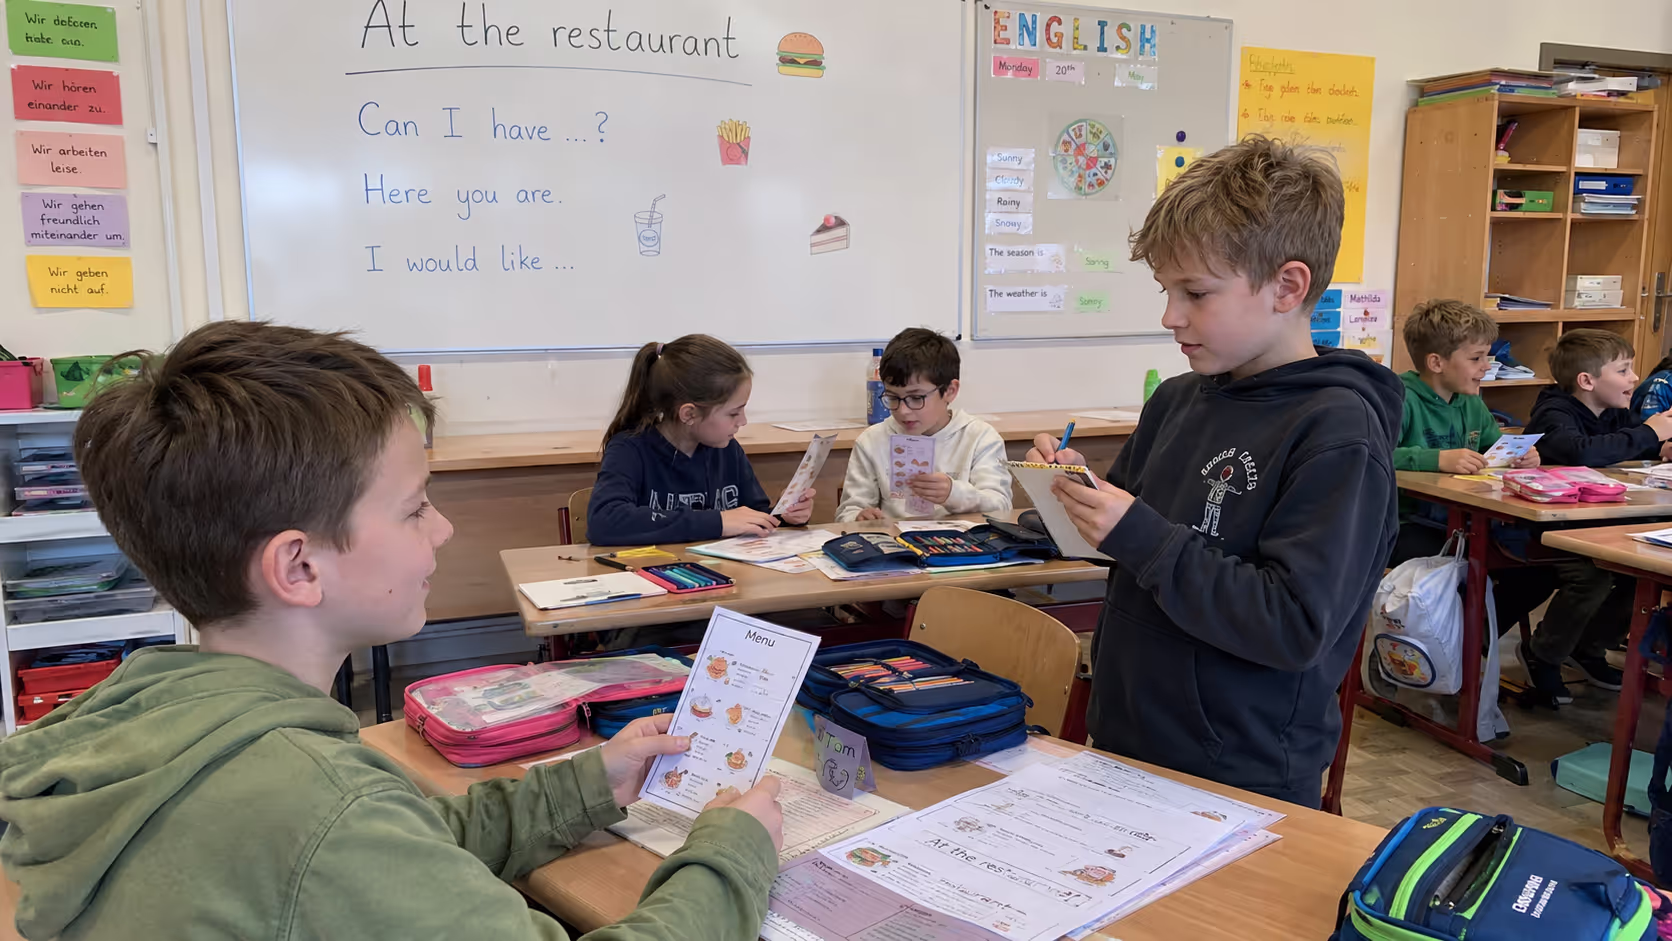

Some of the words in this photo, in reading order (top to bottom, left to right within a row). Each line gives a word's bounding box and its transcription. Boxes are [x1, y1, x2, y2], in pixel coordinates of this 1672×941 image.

[24, 11, 47, 25] Wir
[361, 0, 419, 49] At
[456, 1, 524, 47] the
[552, 9, 740, 59] restaurant
[993, 10, 1156, 56] ENGLISH
[998, 60, 1033, 76] Monday
[1054, 64, 1076, 76] 20th
[31, 79, 54, 91] Wir
[61, 79, 97, 94] hören
[27, 99, 79, 112] einander
[87, 104, 107, 114] zu.
[358, 101, 419, 137] Can
[441, 107, 463, 138] I
[491, 107, 551, 141] have
[31, 143, 53, 155] Wir
[58, 145, 108, 158] arbeiten
[997, 152, 1023, 165] Sunny
[50, 160, 82, 174] leise.
[364, 172, 432, 205] Here
[457, 189, 499, 221] you
[516, 188, 562, 204] are.
[41, 198, 63, 209] Wir
[70, 199, 105, 215] gehen
[39, 213, 101, 226] freundlich
[30, 229, 99, 241] miteinander
[105, 233, 126, 242] um.
[364, 245, 384, 273] I
[406, 244, 479, 273] would
[501, 244, 543, 272] like
[989, 248, 1004, 257] The
[1007, 249, 1035, 257] season
[1037, 247, 1045, 257] is
[47, 266, 69, 277] Wir
[75, 267, 109, 282] geben
[50, 283, 80, 295] nicht
[86, 283, 109, 295] auf.
[988, 289, 1004, 298] The
[1006, 289, 1038, 298] weather
[1040, 289, 1048, 297] is
[744, 629, 776, 647] Menu
[949, 846, 977, 863] the
